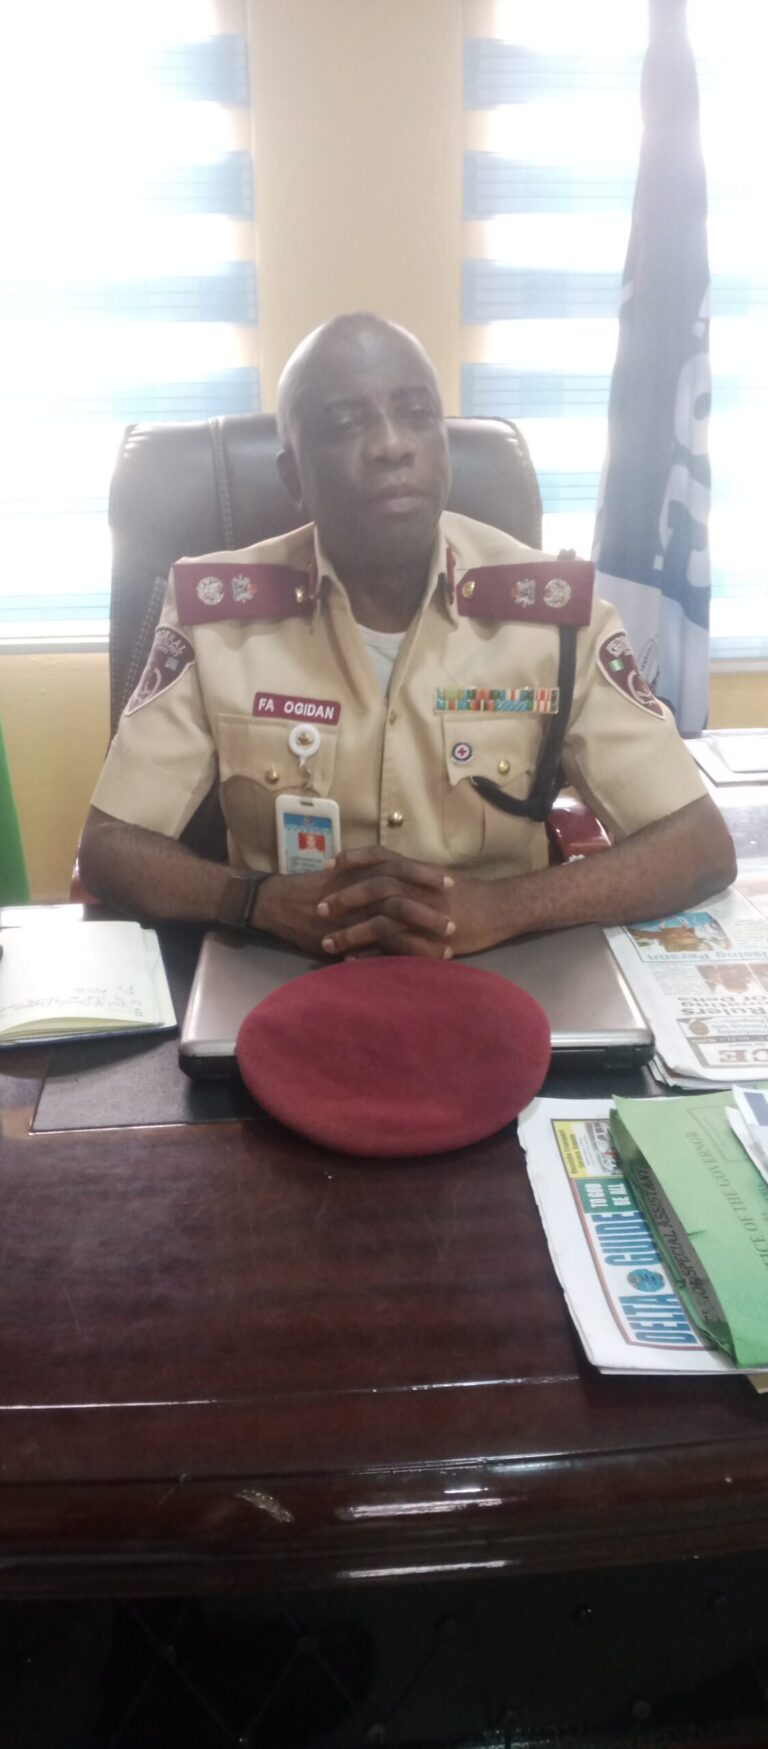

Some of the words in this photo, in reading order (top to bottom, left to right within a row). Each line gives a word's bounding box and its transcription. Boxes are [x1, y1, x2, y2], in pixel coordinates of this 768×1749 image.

[258, 698, 275, 712] FA
[283, 700, 335, 720] OGIDAN
[681, 1007, 767, 1015] Rulers
[685, 1131, 731, 1187] GOVERNOR
[585, 1183, 605, 1197] GOD
[607, 1183, 628, 1195] ALL
[638, 1168, 671, 1228] ASSISTANT
[723, 1188, 747, 1212] THE
[589, 1198, 608, 1208] TO
[611, 1196, 631, 1206] BE
[591, 1211, 663, 1266] GUIDE
[664, 1229, 697, 1278] SPECIAL
[618, 1293, 698, 1344] DELTA
